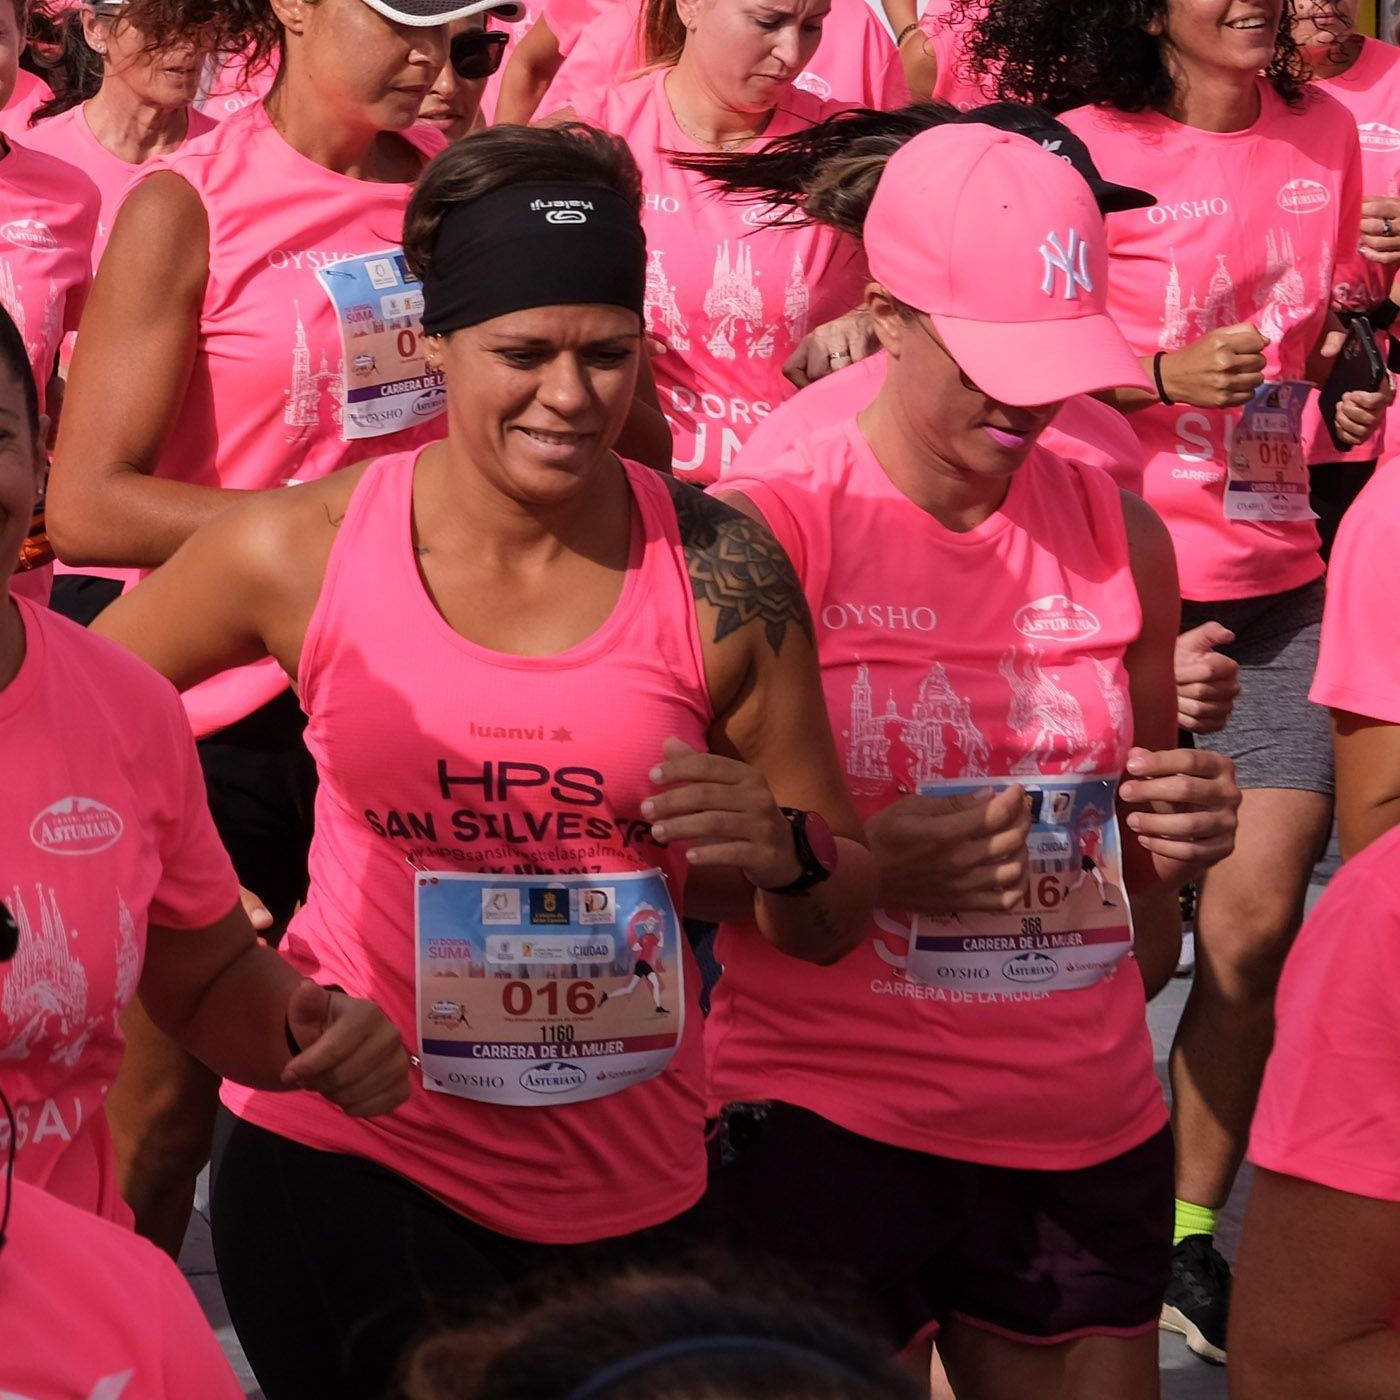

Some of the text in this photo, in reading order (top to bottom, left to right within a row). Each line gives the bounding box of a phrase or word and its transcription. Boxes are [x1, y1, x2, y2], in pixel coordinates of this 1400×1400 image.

[1146, 197, 1229, 225] OYSHO
[380, 376, 436, 397] CARRERA DE
[671, 386, 773, 424] DORS
[821, 603, 937, 632] OYSHO
[1022, 613, 1100, 633] ASTURIANA
[470, 722, 545, 741] luanvi
[437, 760, 604, 806] HPS
[41, 819, 118, 845] ASTURIANA
[364, 808, 668, 850] SAN SILVESTR
[1021, 917, 1042, 934] 368
[427, 946, 472, 960] SUMA
[573, 944, 609, 958] CIUDAD
[962, 935, 1052, 952] CARRERA DE LA
[936, 966, 991, 980] OYSHO
[502, 980, 596, 1017] 016
[539, 1025, 574, 1042] 1160
[472, 1040, 624, 1060] CARRERA DE LA MUJER
[448, 1072, 505, 1089] OYSHO
